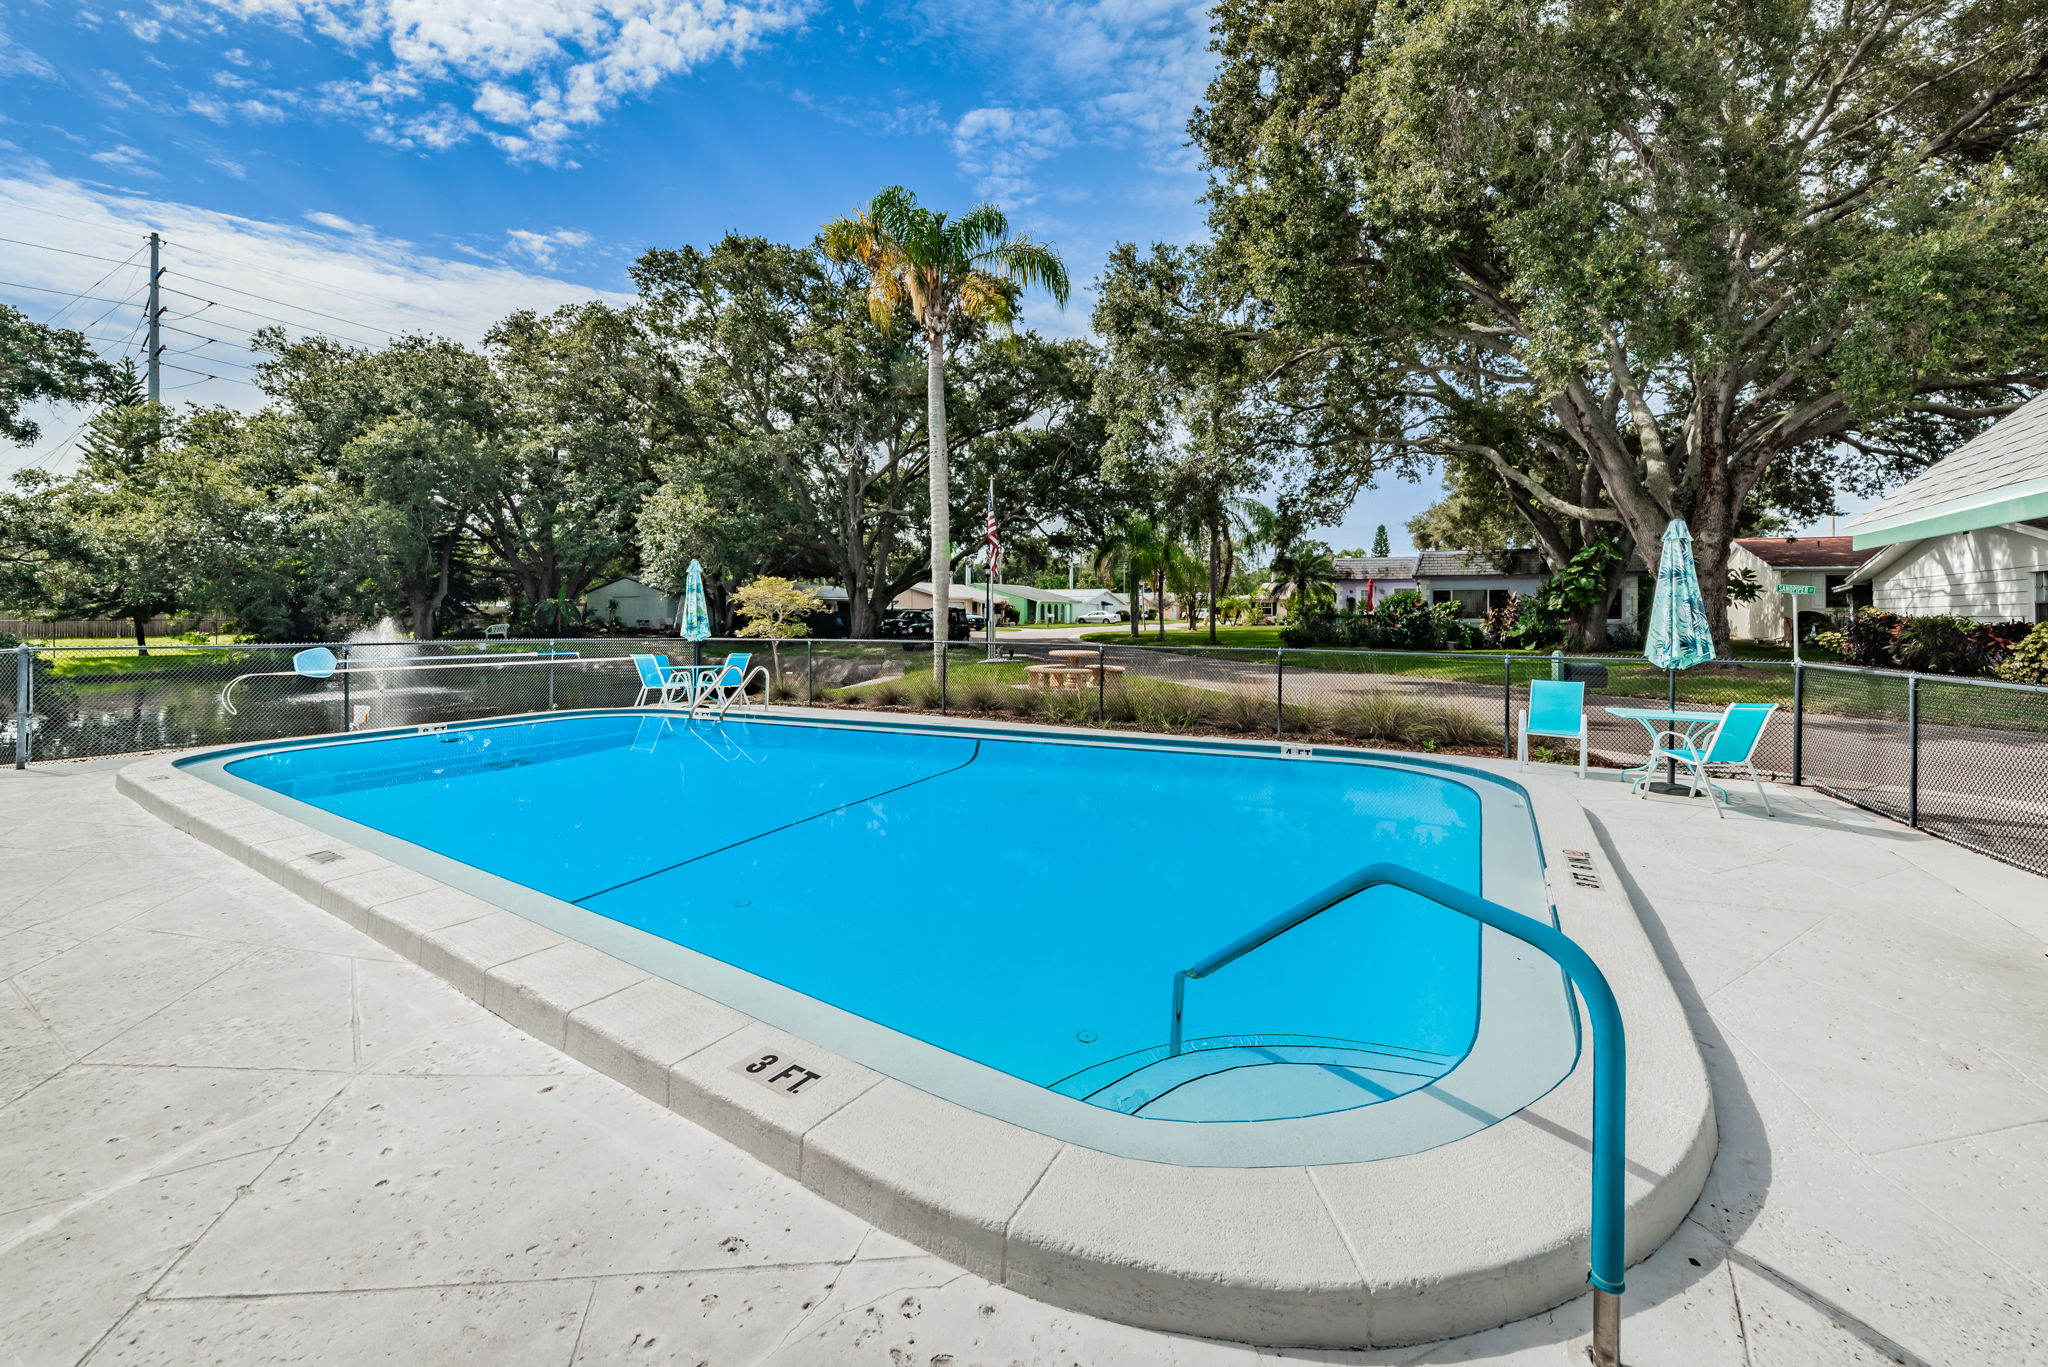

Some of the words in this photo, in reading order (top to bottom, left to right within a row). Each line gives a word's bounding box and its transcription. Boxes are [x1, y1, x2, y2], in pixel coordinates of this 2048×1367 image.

[1573, 872, 1598, 882] FT
[746, 1054, 779, 1073] 3
[768, 1064, 822, 1094] FT.
